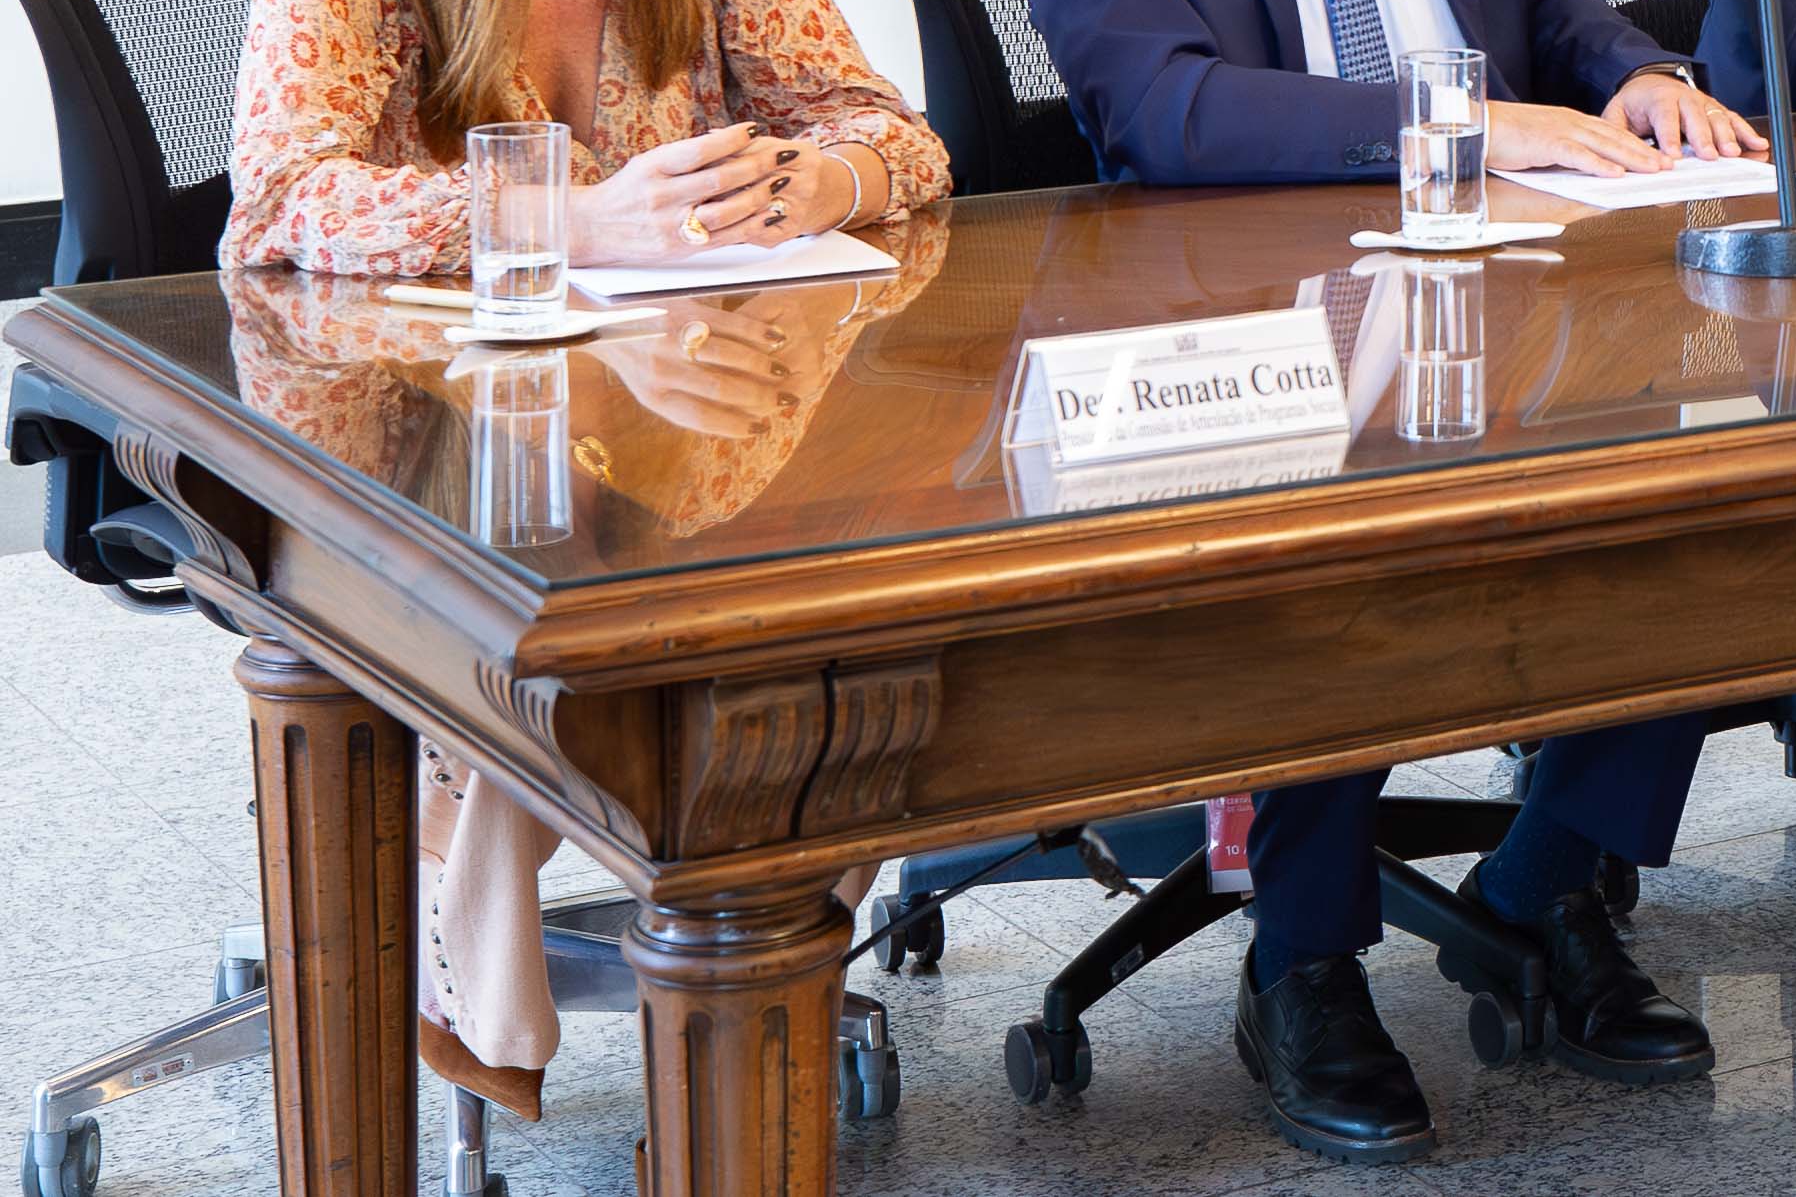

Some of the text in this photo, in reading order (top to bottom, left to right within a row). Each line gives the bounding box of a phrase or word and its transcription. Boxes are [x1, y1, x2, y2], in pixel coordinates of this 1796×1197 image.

[1056, 363, 1334, 422] De. Renata Cotta
